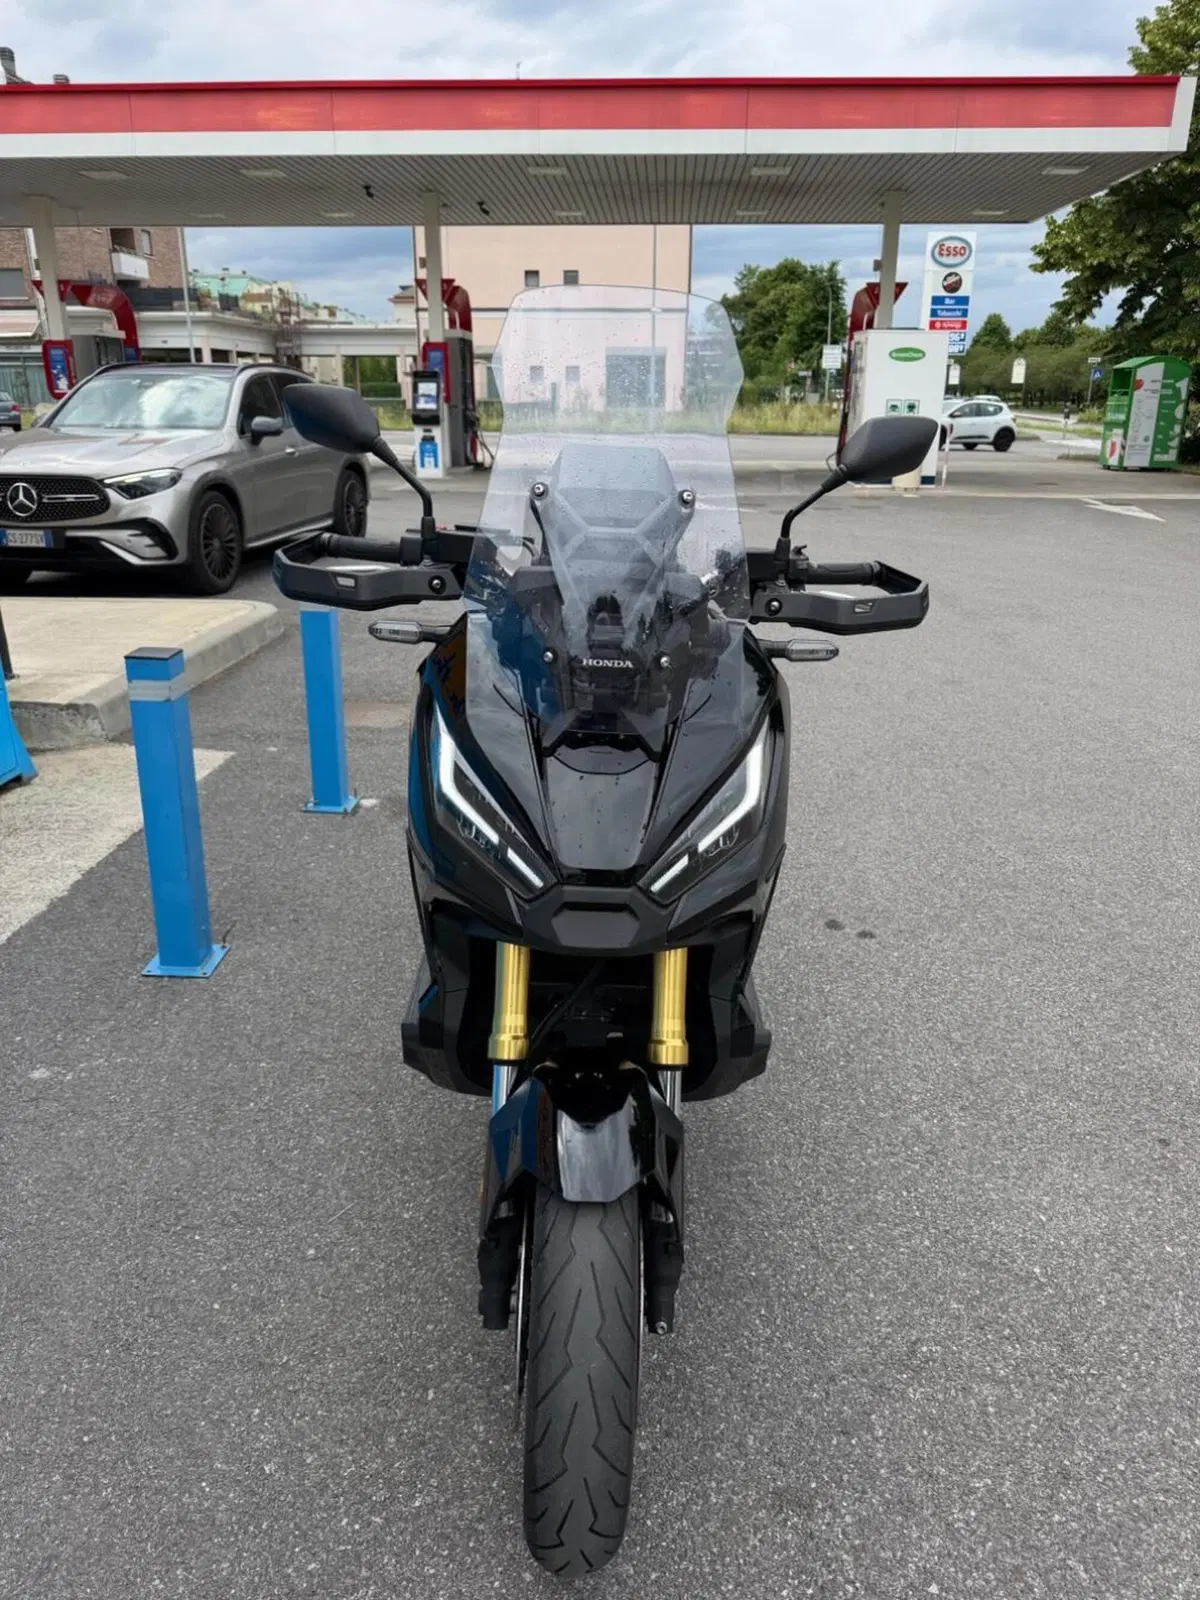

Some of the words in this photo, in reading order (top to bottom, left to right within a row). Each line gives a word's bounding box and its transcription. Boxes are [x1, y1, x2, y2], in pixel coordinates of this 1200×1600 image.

[944, 297, 956, 305] Bar
[936, 309, 963, 317] Tabacchi
[582, 658, 634, 668] HONDA
